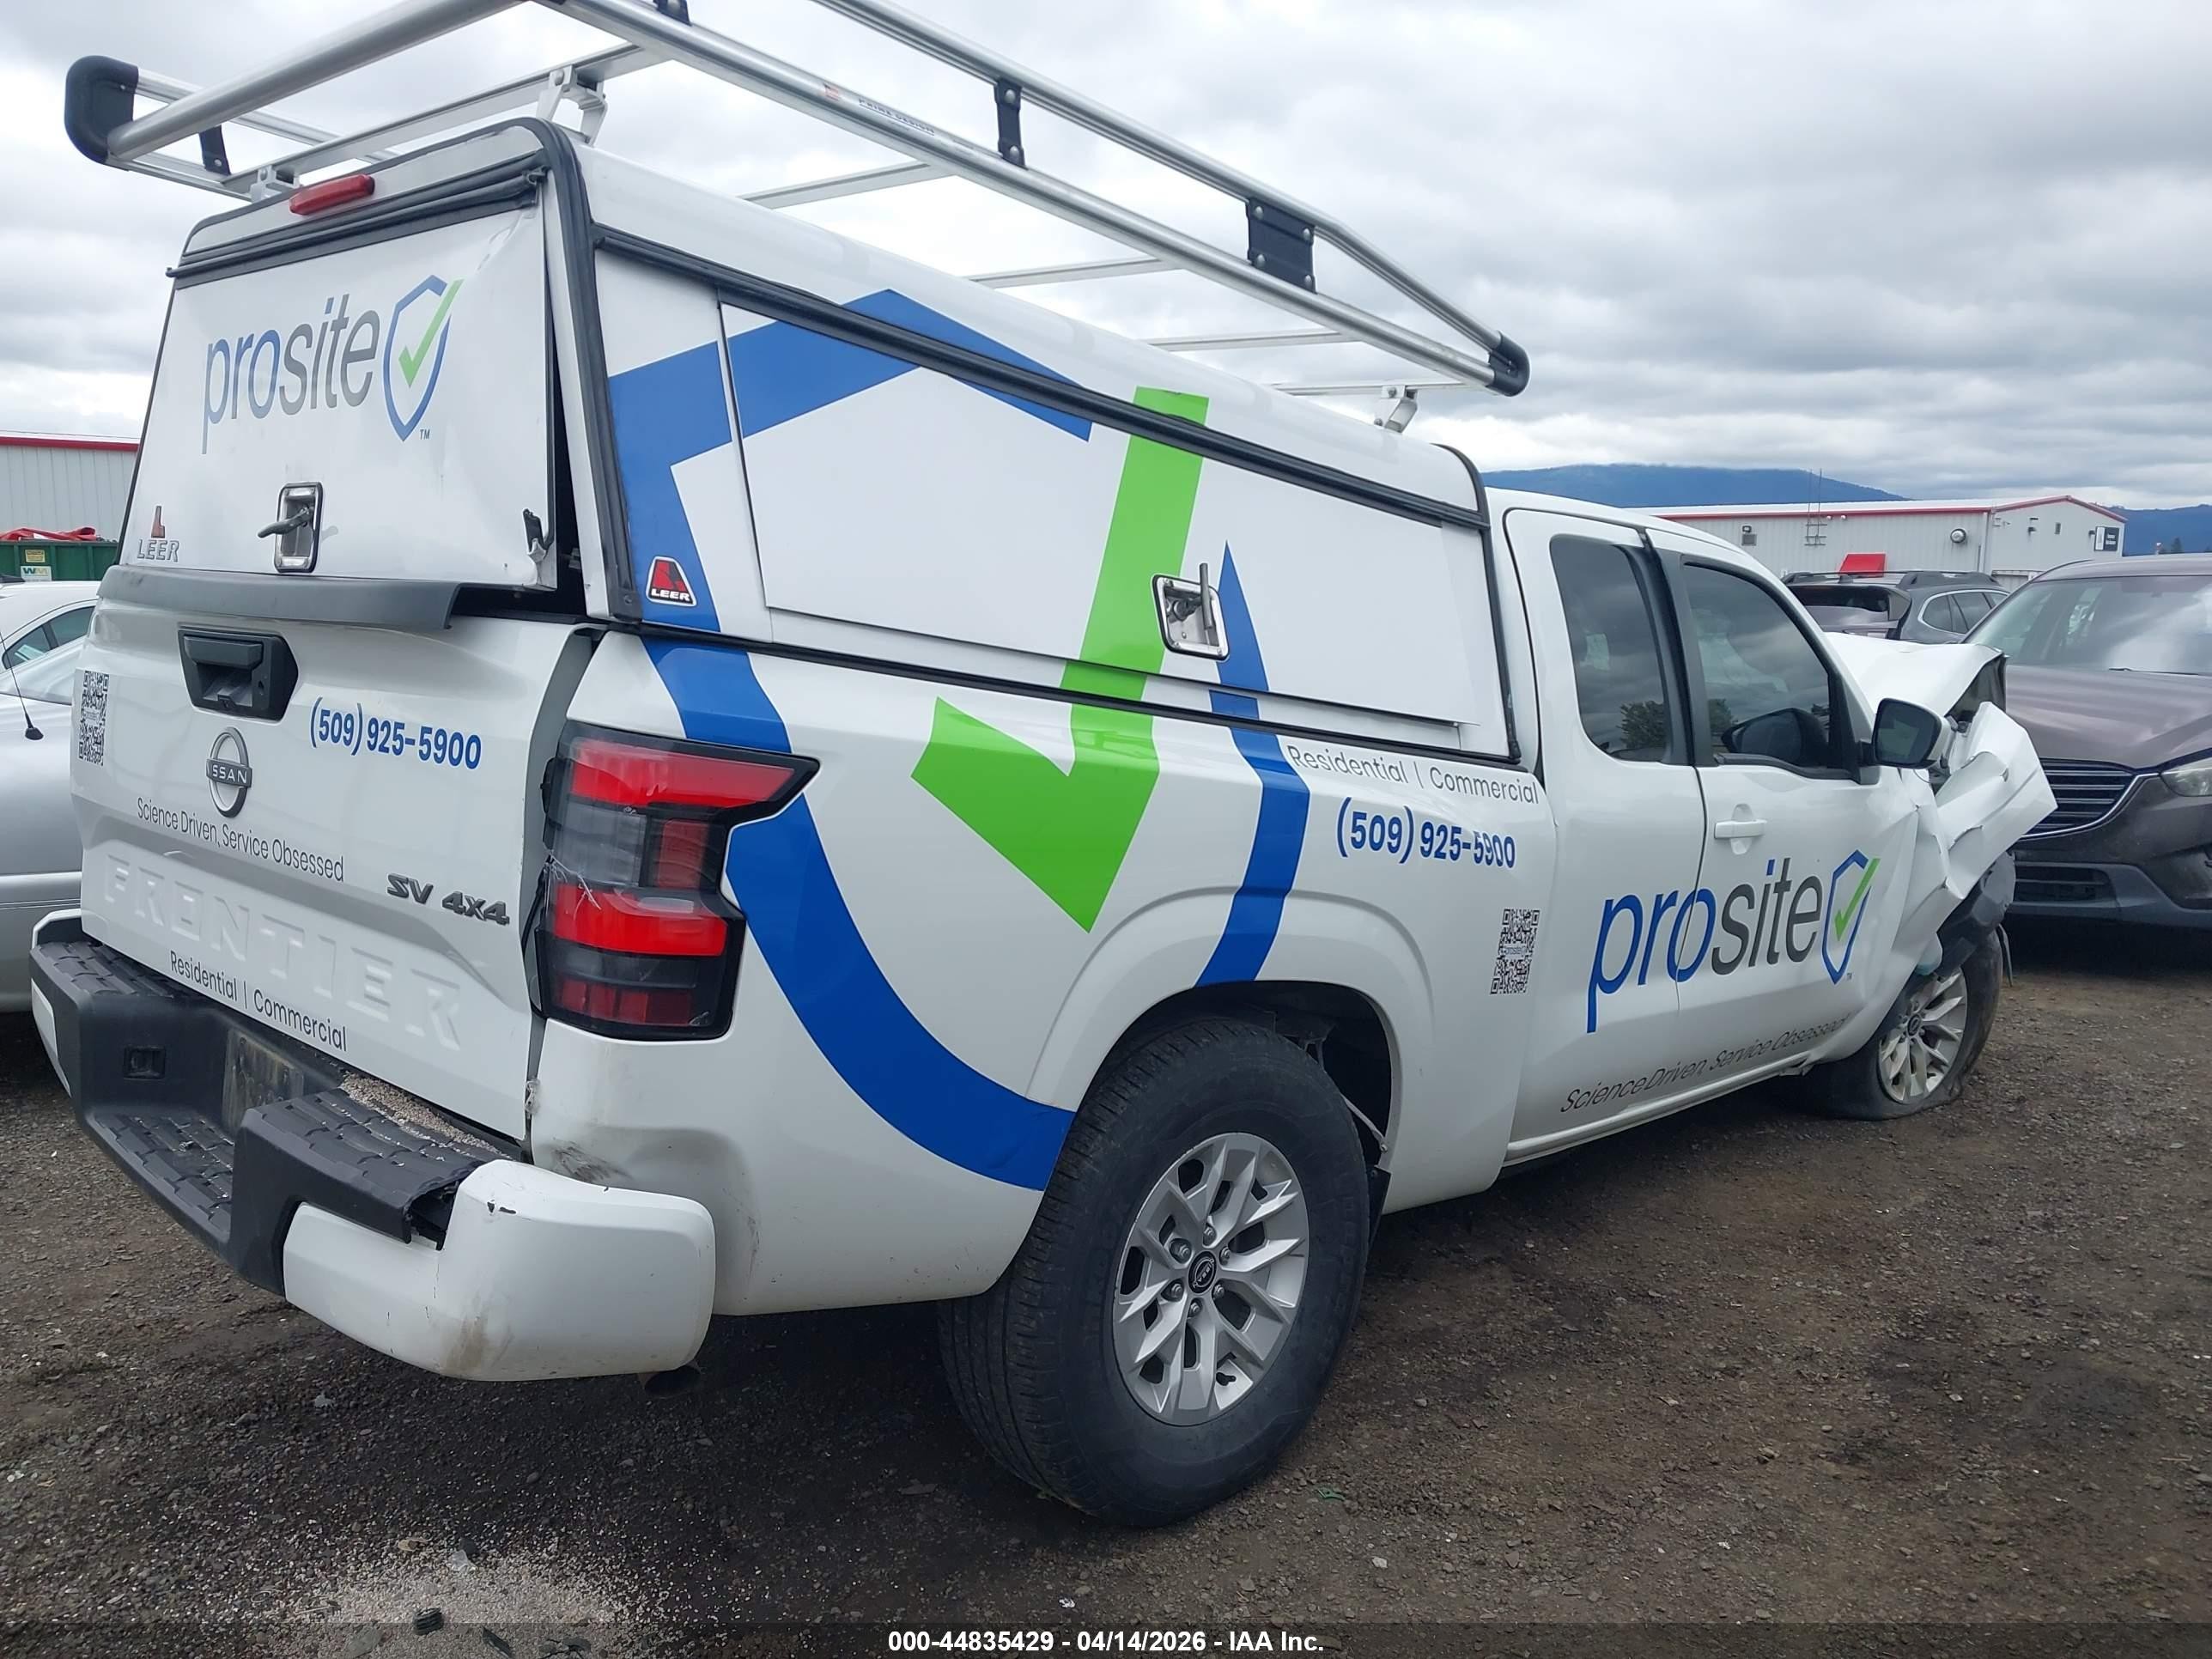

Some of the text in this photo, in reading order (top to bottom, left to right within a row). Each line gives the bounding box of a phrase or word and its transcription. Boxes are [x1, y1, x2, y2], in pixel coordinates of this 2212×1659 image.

[201, 294, 380, 454] prosite
[419, 428, 430, 440] TM
[137, 538, 179, 562] LEER
[651, 588, 690, 601] LEER
[311, 696, 482, 770] (509) 925-5900
[1287, 745, 1409, 783] Residential
[1430, 767, 1540, 804] Commercial
[137, 797, 344, 883] Science Driven, Service Obsessed
[1337, 797, 1516, 869] (509) 925-5900
[386, 872, 434, 905] SV
[104, 854, 461, 1052] FRONTIER
[1586, 857, 1823, 1034] prosite
[170, 950, 238, 1002] Residential
[253, 988, 348, 1052] Commercial
[1559, 1077, 1647, 1114] Science
[1710, 1038, 1773, 1072] Service
